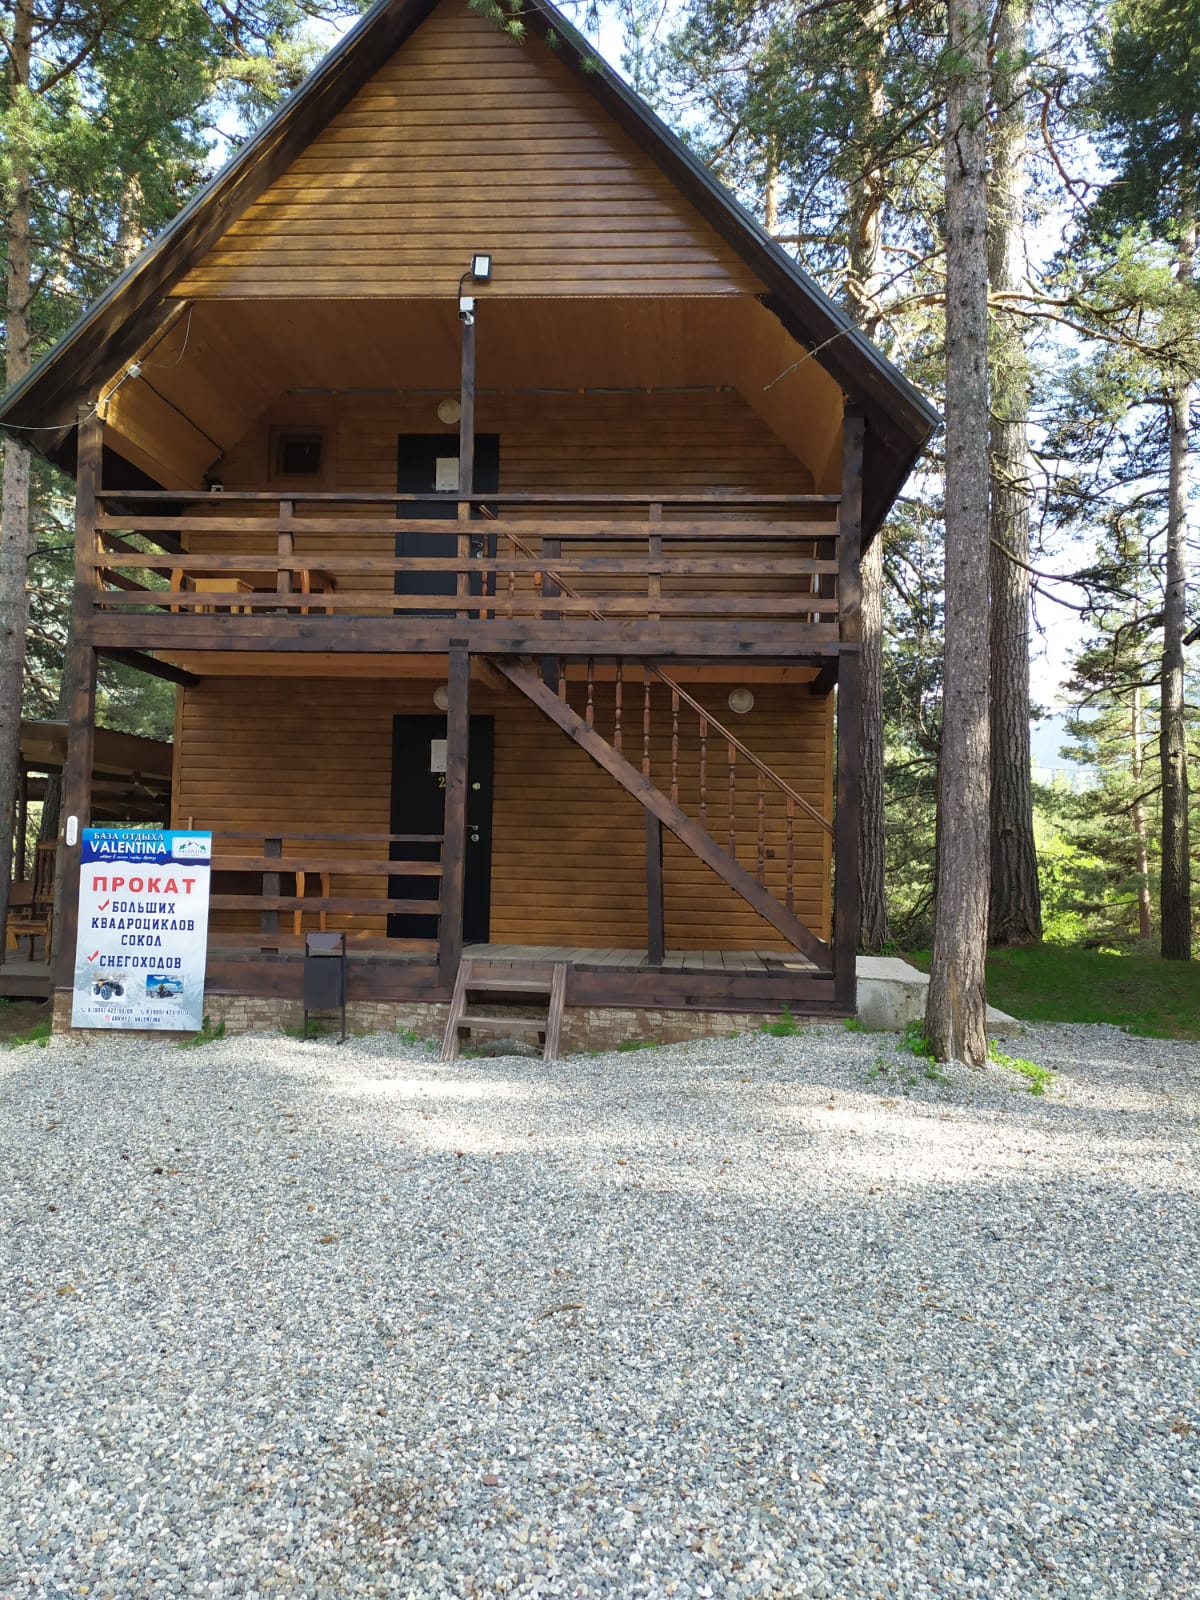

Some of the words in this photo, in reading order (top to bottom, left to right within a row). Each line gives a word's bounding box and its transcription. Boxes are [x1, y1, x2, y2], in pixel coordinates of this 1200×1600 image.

[438, 776, 446, 788] 2
[94, 832, 118, 840] БАЗА
[122, 833, 164, 842] ОТДЫХА
[90, 841, 167, 854] VALENTINA
[92, 876, 196, 894] ПРОКАТ
[112, 901, 175, 914] БОЛЬШИХ
[91, 917, 194, 931] КВАДРОЦИКЛОВ
[121, 934, 162, 947] СОКОЛ
[99, 955, 182, 969] СНЕГОХОДОВ
